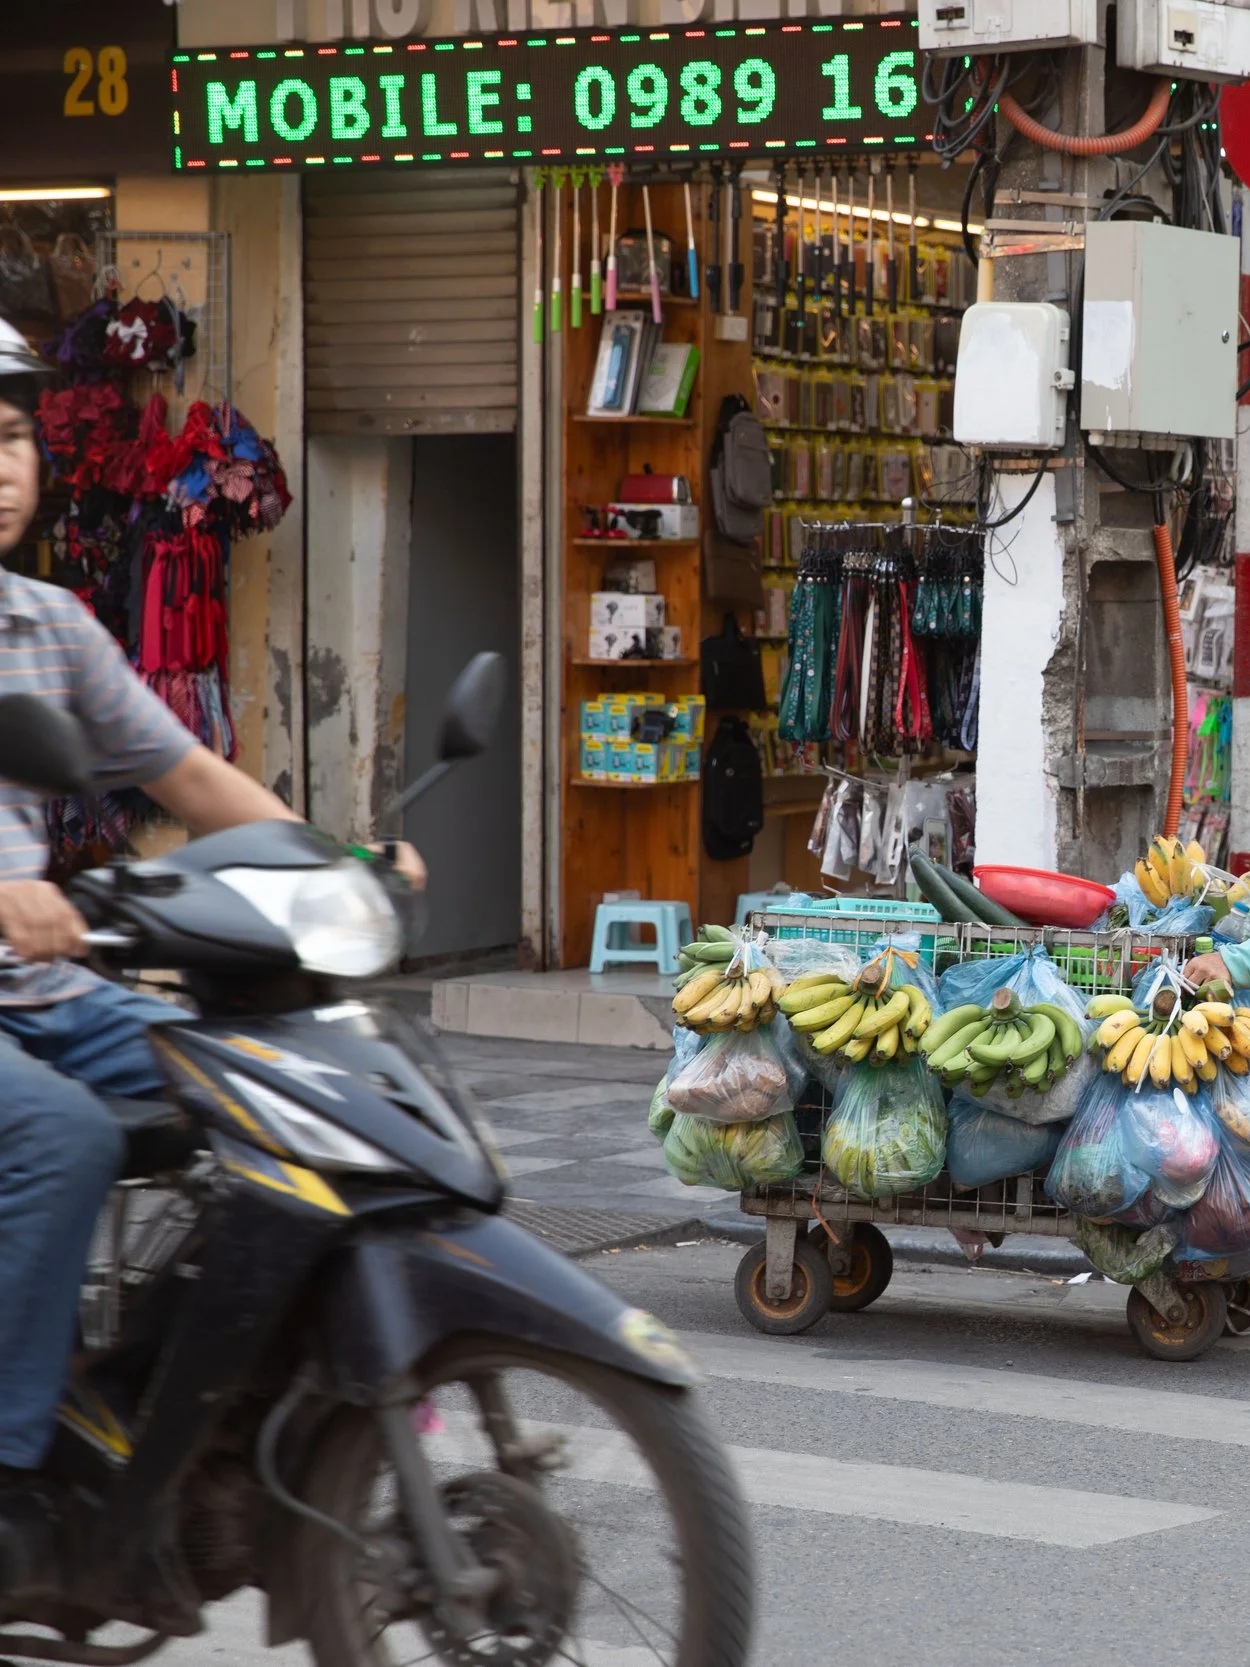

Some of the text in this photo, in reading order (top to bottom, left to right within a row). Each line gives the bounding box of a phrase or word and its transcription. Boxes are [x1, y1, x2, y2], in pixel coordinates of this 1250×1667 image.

[63, 45, 128, 117] 28
[206, 51, 917, 144] MOBILE: 0989 16
